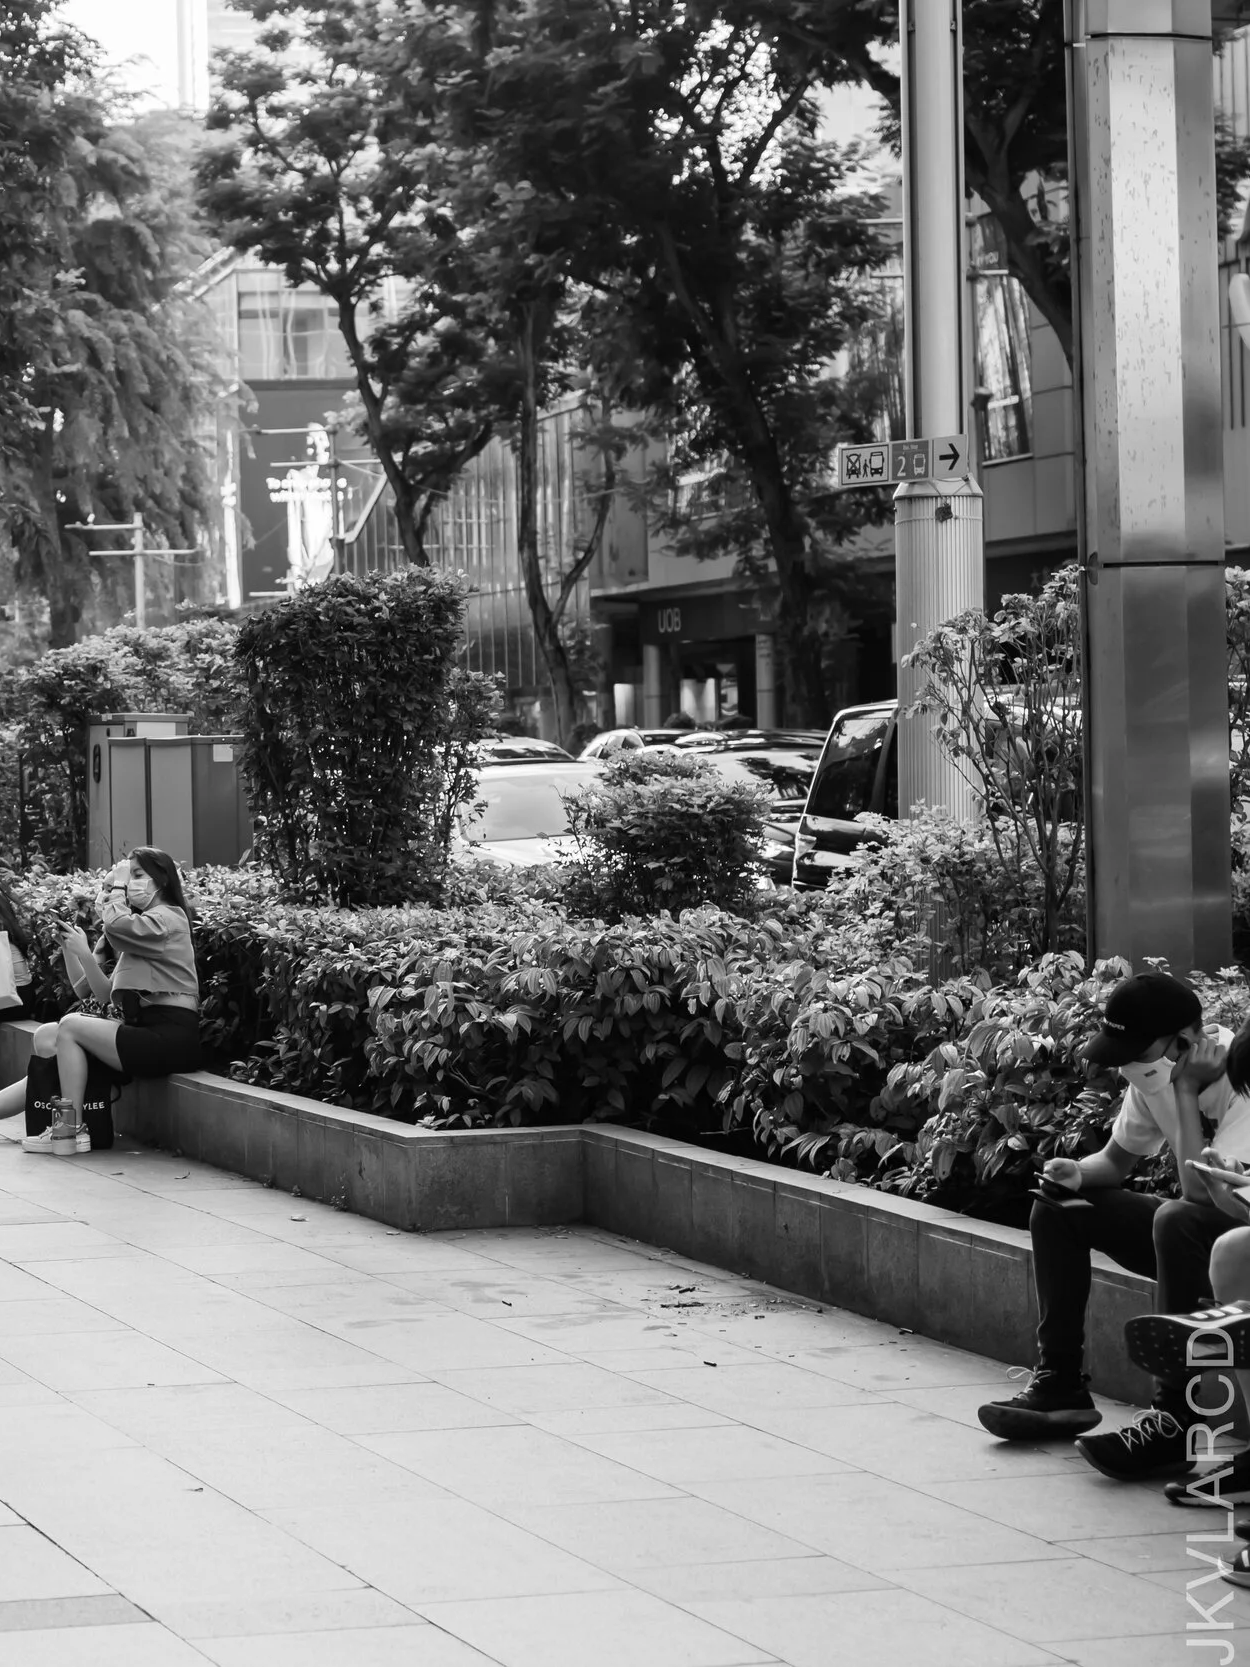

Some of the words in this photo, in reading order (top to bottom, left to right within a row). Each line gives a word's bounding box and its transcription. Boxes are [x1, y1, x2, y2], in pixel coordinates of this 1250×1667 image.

[897, 455, 906, 477] 2
[657, 607, 682, 633] UOB
[34, 1101, 52, 1110] OSC
[82, 1101, 105, 1111] YLEE
